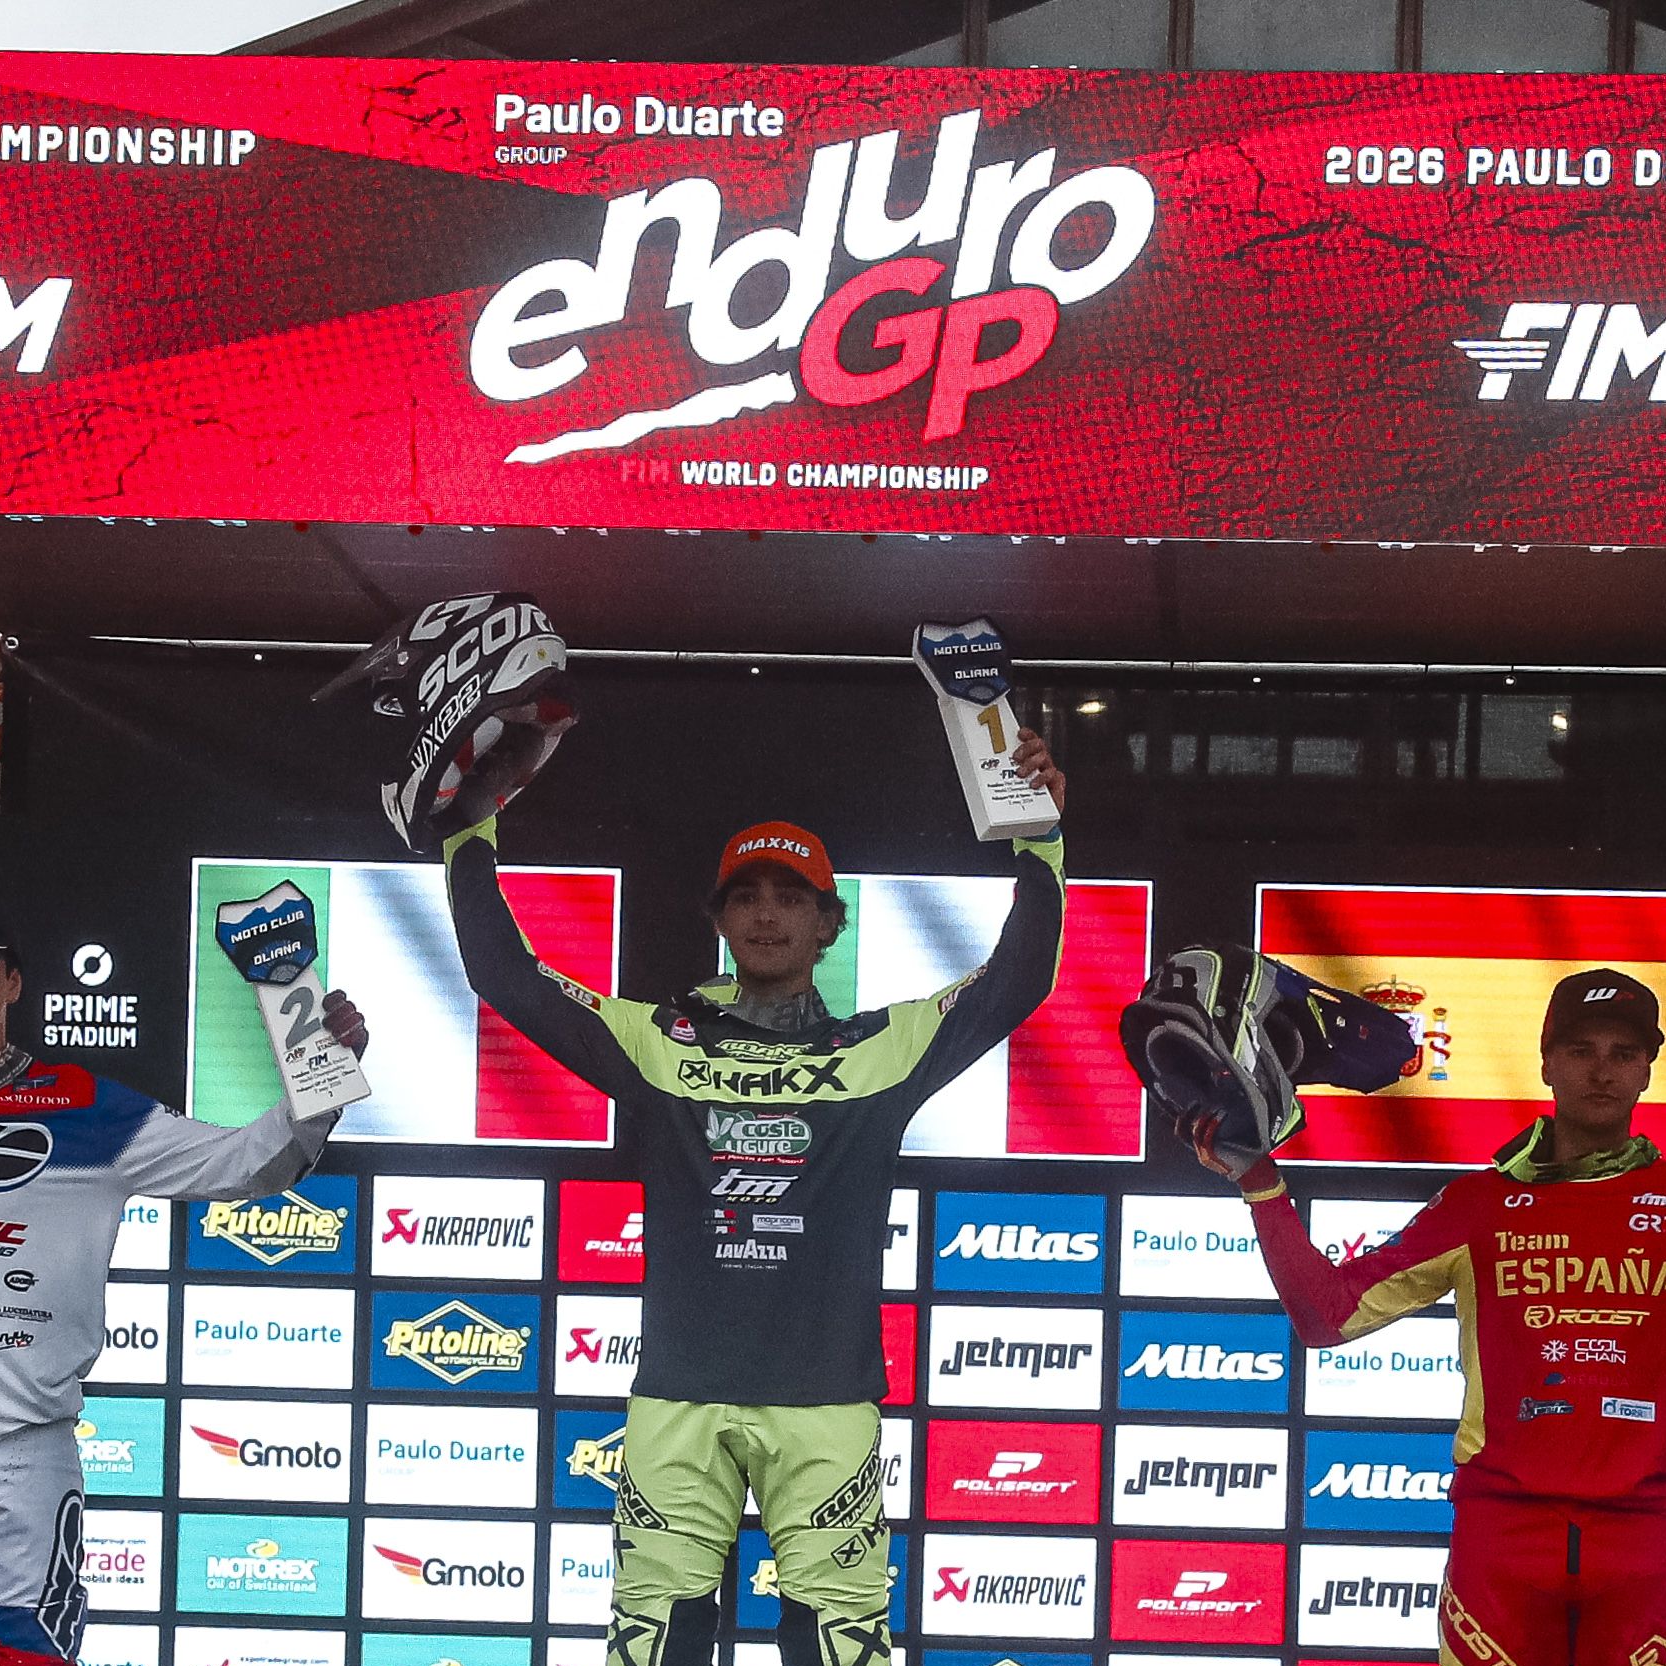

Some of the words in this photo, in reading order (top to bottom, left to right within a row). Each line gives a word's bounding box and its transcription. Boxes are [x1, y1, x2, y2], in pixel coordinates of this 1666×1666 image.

[495, 96, 621, 136] Paulo
[635, 99, 784, 138] Duarte
[495, 147, 567, 164] GROUP
[1325, 146, 1444, 187] 2026
[1467, 147, 1612, 188] PAULO
[799, 257, 1058, 441] GP
[682, 462, 776, 488] WORLD
[787, 465, 988, 490] CHAMPIONSHIP
[934, 645, 967, 655] MOTO
[970, 643, 1001, 652] CLUB
[955, 668, 998, 679] OLIANA
[977, 704, 1006, 754] 1
[735, 837, 812, 859] MAXXIS
[231, 923, 268, 943] MOTO
[271, 910, 305, 930] CLUB
[253, 941, 301, 965] OLIANA
[43, 994, 138, 1024] PRIME
[280, 987, 321, 1049] 2
[43, 1025, 137, 1048] STADIUM
[207, 1205, 338, 1238] Putoline
[715, 1239, 788, 1261] LAVAZZA
[939, 1222, 1101, 1263] Mitas
[1495, 1232, 1570, 1252] Team
[1557, 1309, 1651, 1326] ROOST
[194, 1319, 259, 1342] Paulo
[267, 1321, 342, 1344] Duarte
[1575, 1352, 1626, 1364] CHAIN
[239, 1437, 343, 1470] Gmoto
[377, 1438, 442, 1461] Paulo
[449, 1440, 525, 1463] Duarte
[953, 1478, 1074, 1494] POLISPORT
